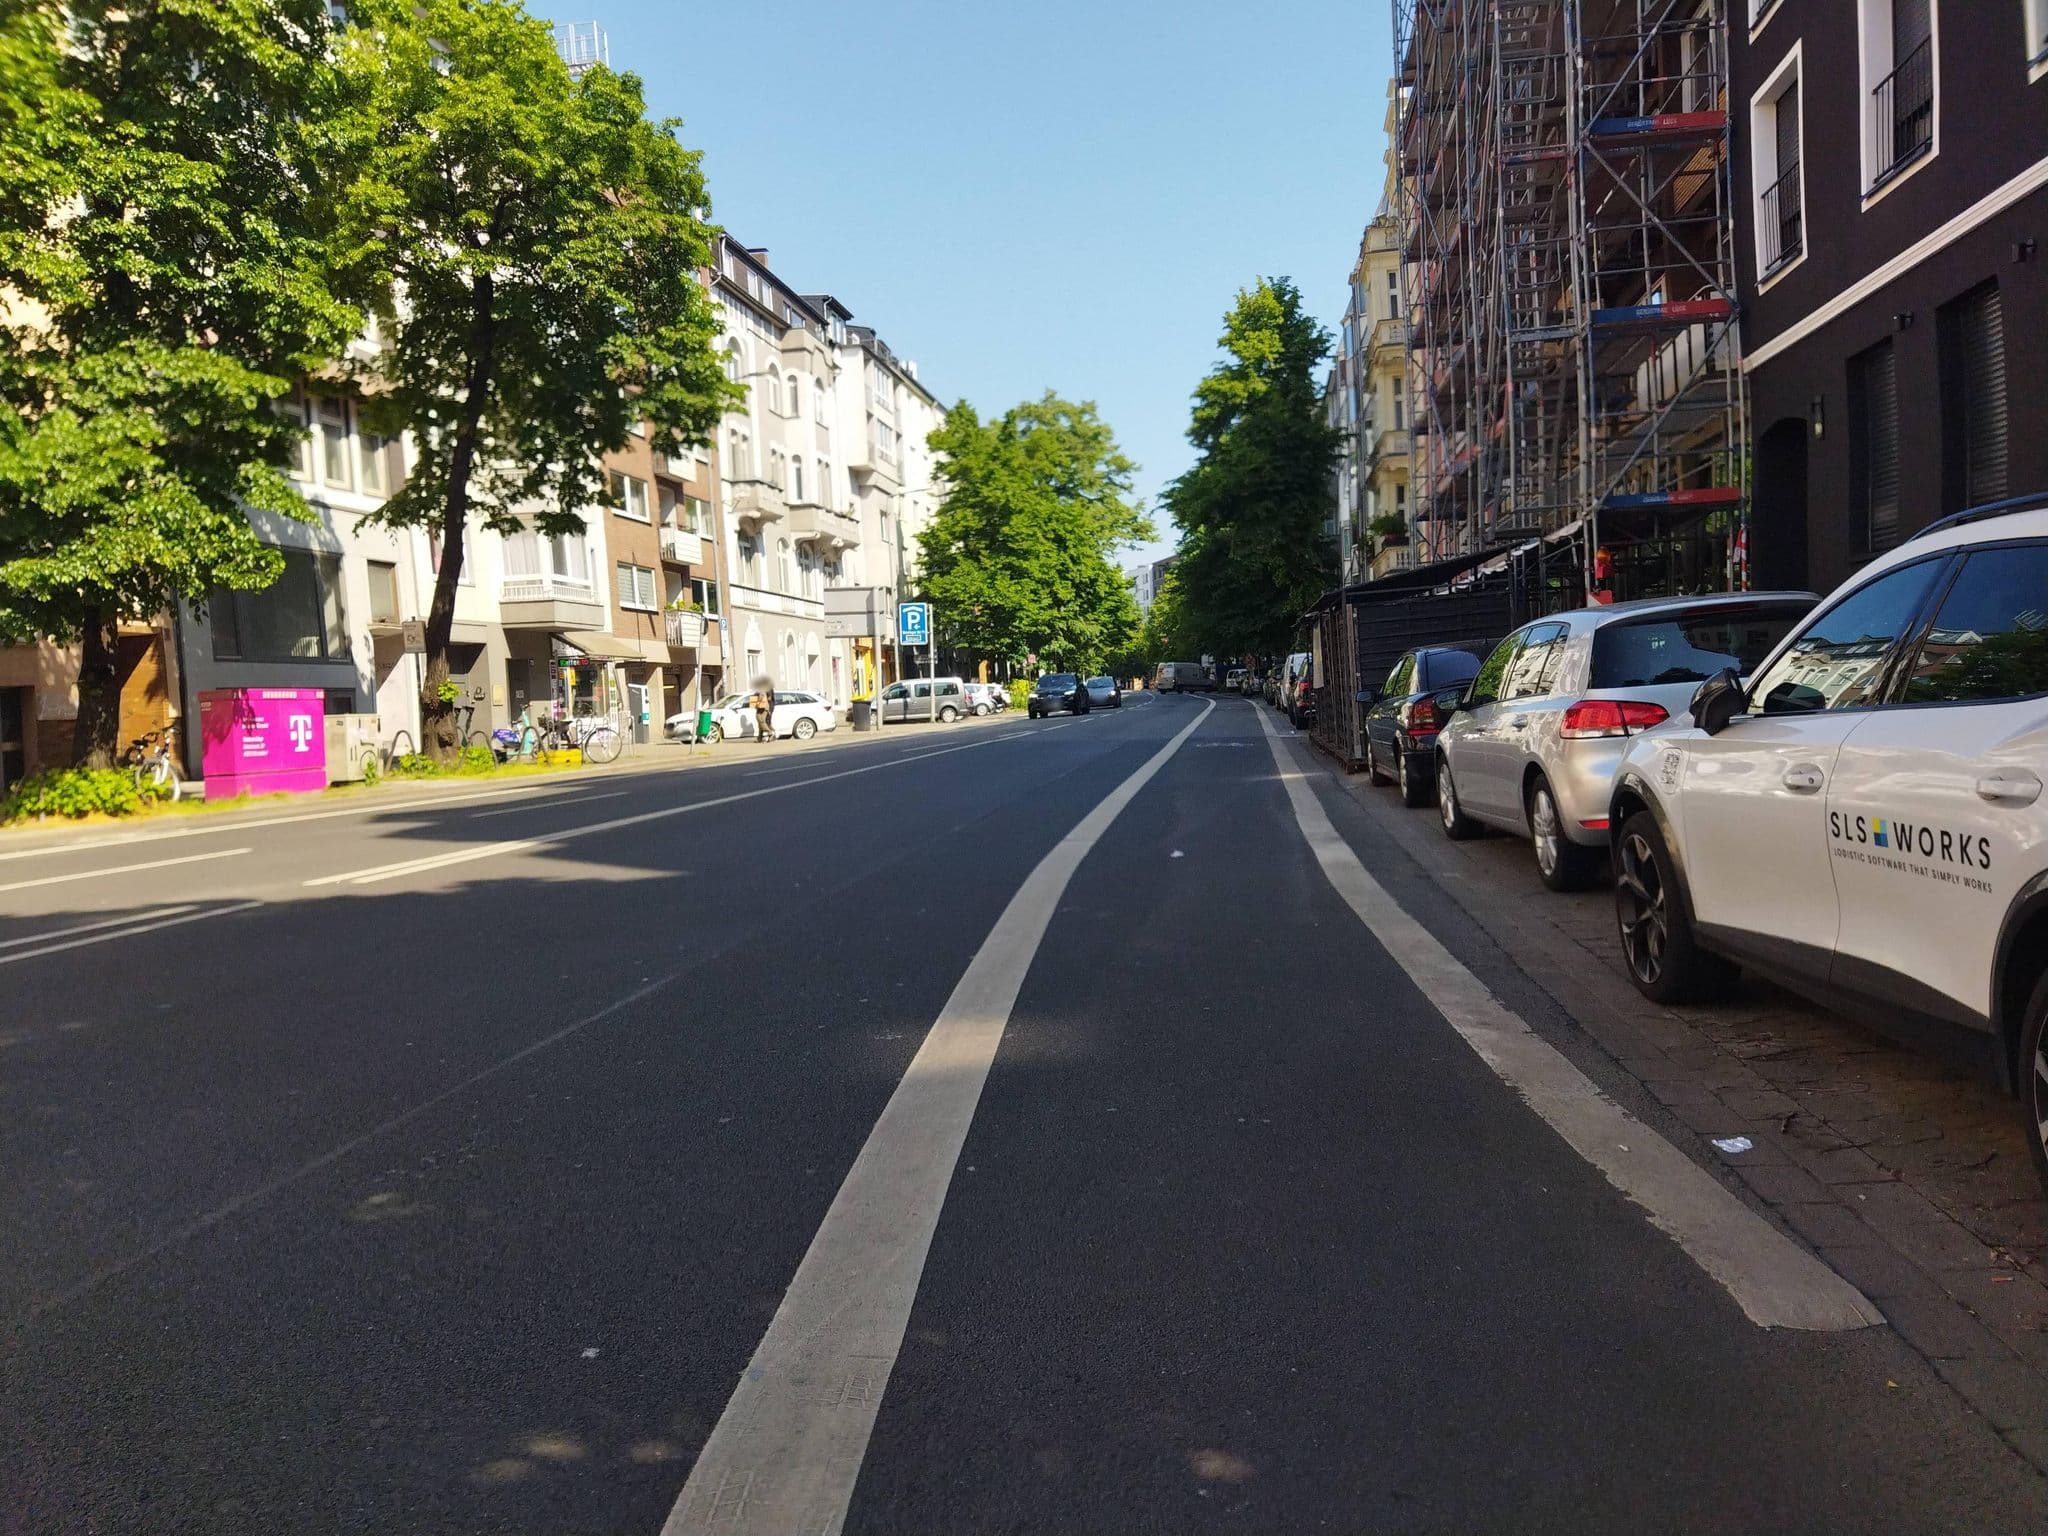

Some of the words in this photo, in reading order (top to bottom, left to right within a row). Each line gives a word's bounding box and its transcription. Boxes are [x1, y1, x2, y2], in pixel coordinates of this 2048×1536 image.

[907, 611, 921, 630] P
[289, 714, 313, 752] T
[1830, 811, 1867, 844] SLS
[1893, 821, 1991, 870] WORKS
[1834, 847, 1866, 863] LOGISTIC
[1867, 854, 1907, 872] SOFTWARE
[1908, 863, 1928, 876] THAT
[1931, 869, 1960, 885] SIMPLY
[1963, 876, 1992, 893] WORKS
